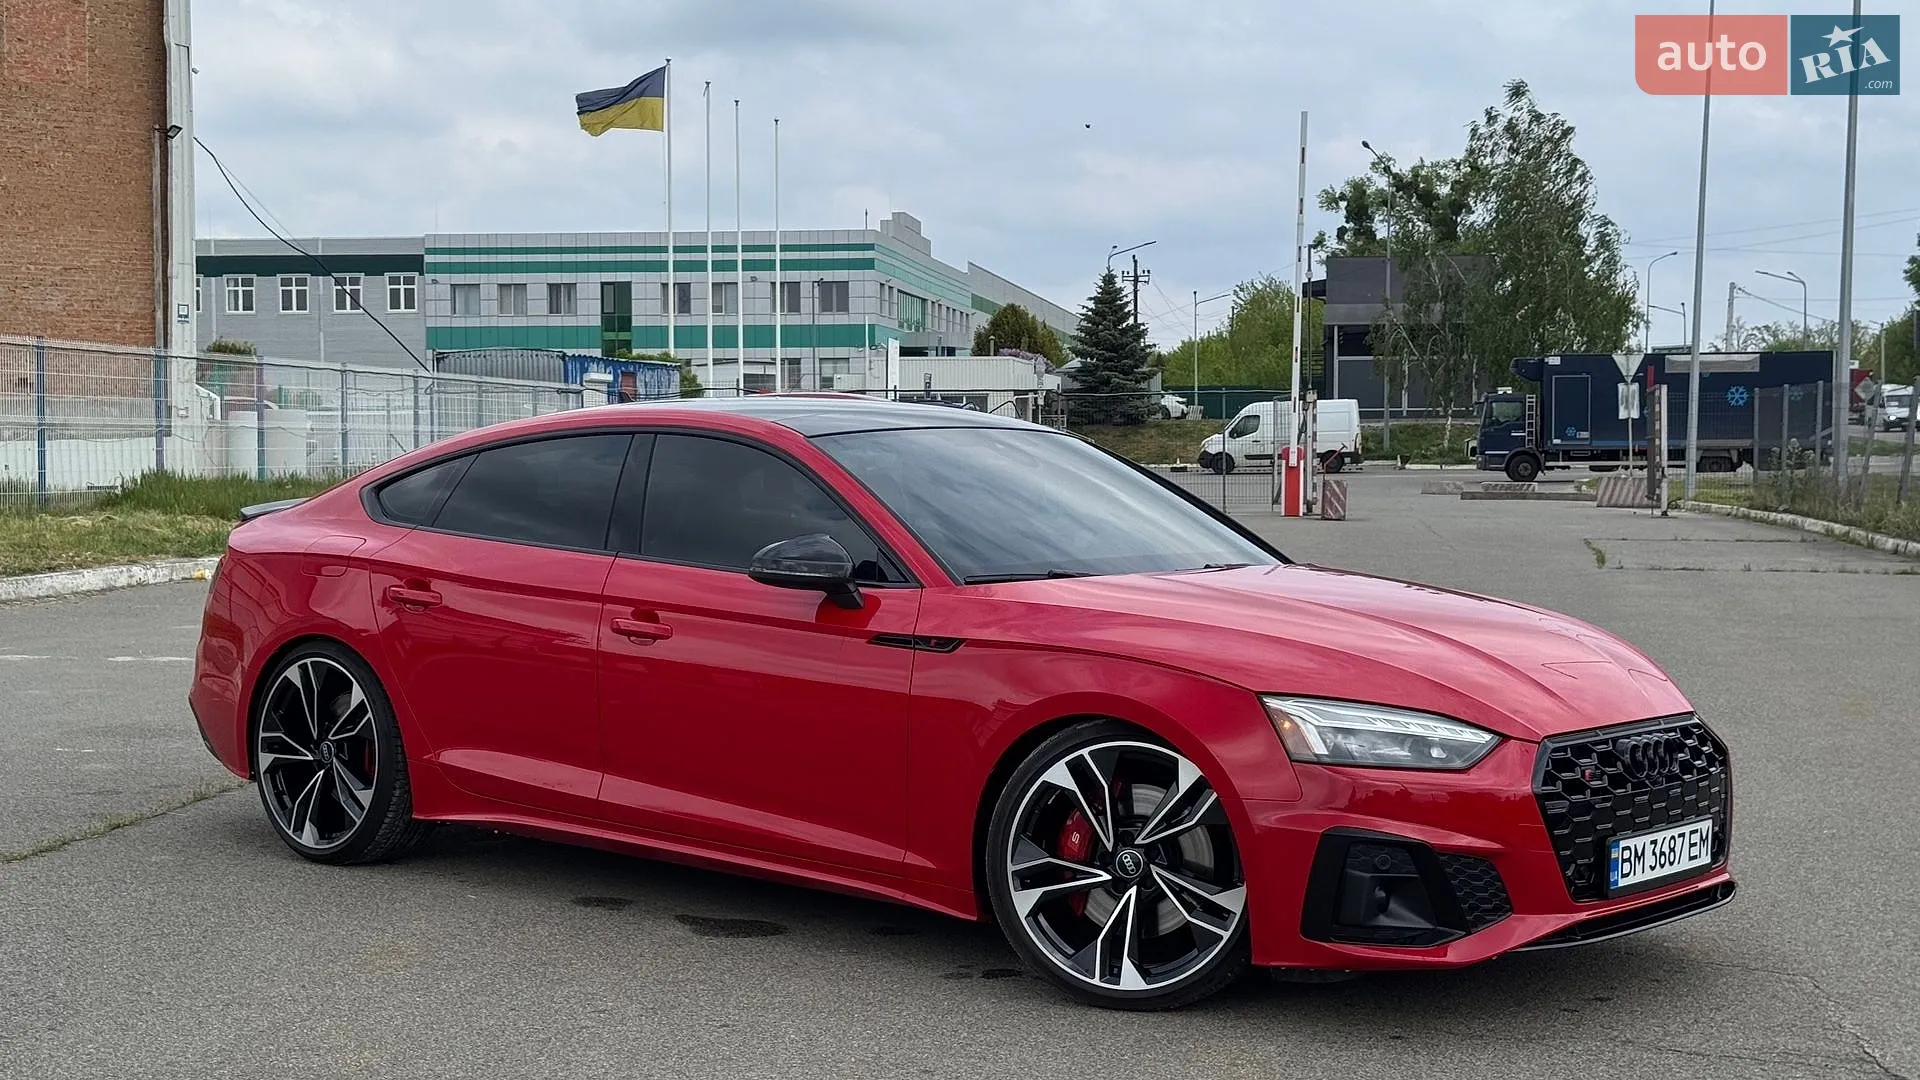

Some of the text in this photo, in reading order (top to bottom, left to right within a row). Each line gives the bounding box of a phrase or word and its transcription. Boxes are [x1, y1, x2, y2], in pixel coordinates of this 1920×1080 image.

[1620, 824, 1710, 879] BM 3687 EM
